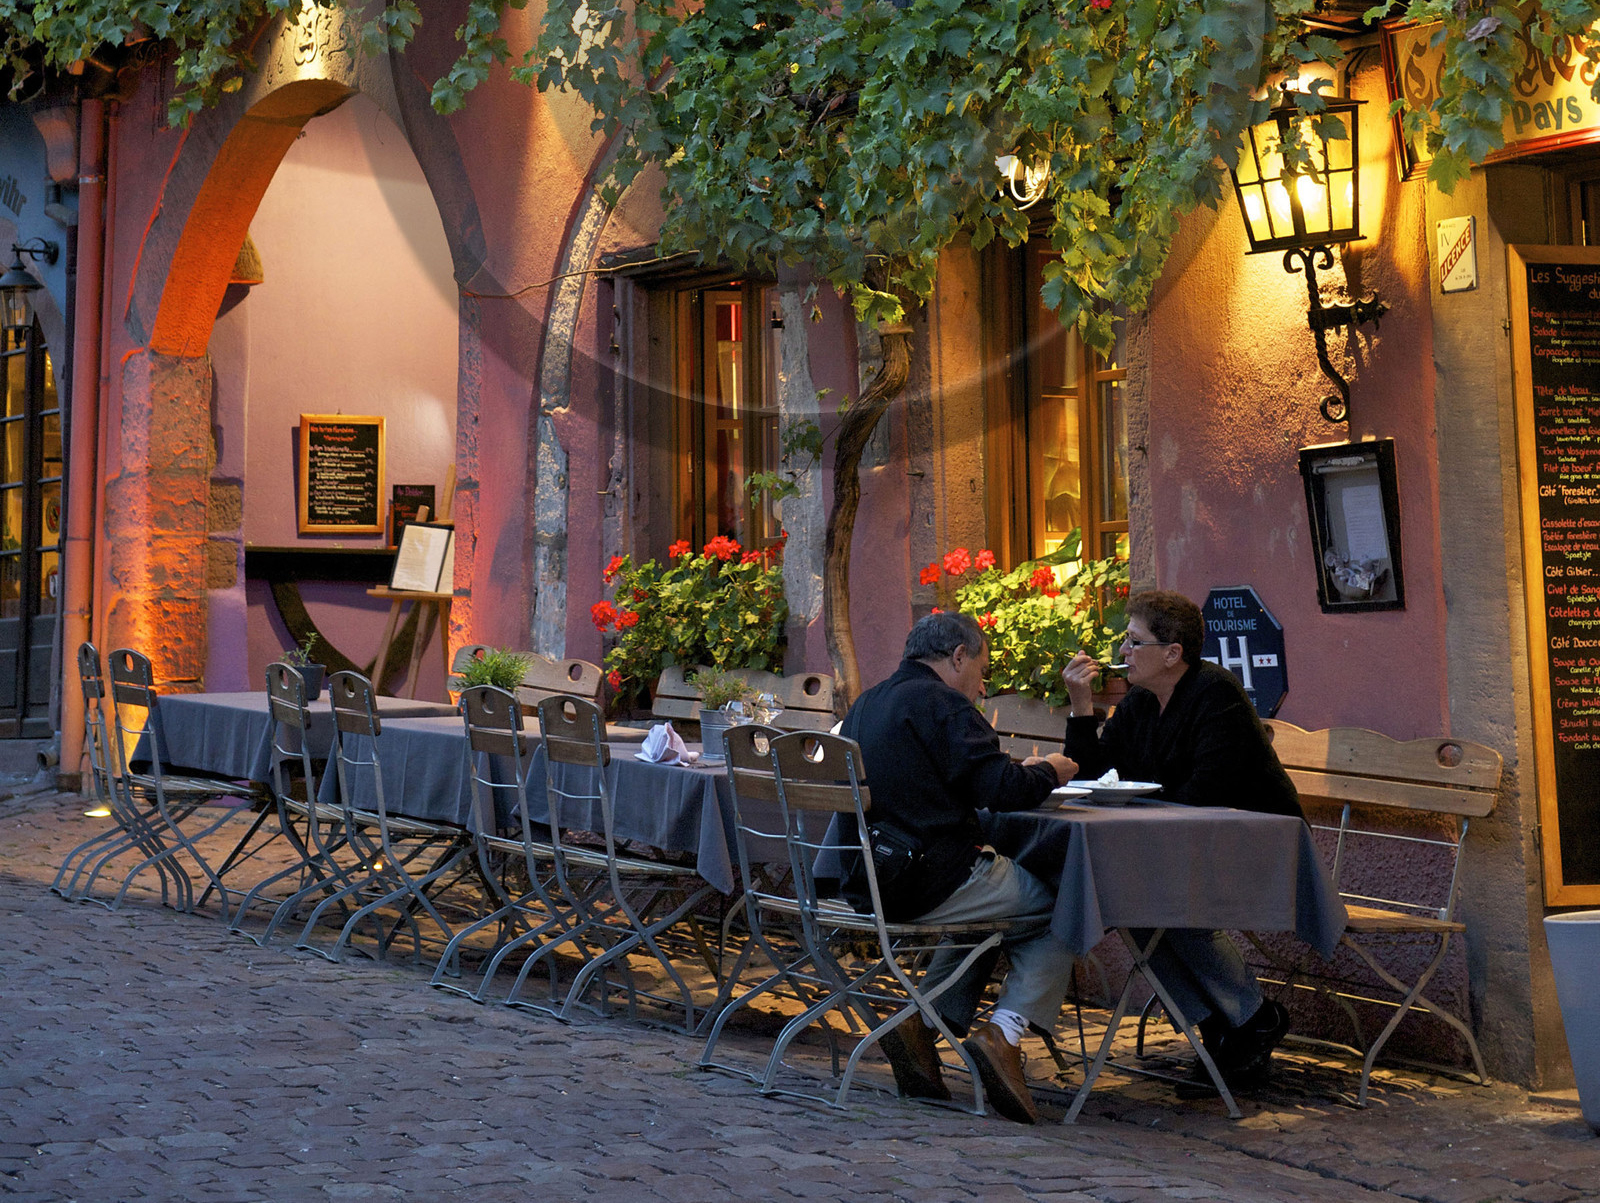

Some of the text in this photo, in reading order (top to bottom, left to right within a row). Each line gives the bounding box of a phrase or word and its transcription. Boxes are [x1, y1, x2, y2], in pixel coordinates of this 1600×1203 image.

[1440, 223, 1471, 283] LICENCE
[1530, 267, 1550, 284] Les
[1533, 325, 1558, 336] Salade
[1534, 344, 1569, 358] Carpaccio
[1571, 349, 1581, 358] de
[1557, 385, 1567, 395] de
[1538, 406, 1561, 416] Jarret
[1539, 425, 1576, 435] Quenelles
[1577, 426, 1587, 435] de
[1539, 445, 1564, 456] Tourte
[1543, 462, 1559, 473] Filet
[1560, 463, 1570, 473] de
[1571, 462, 1594, 473] boeuf
[1539, 484, 1557, 497] Côté
[1541, 518, 1576, 529] Cassolette
[1543, 542, 1572, 554] Escalope
[1572, 542, 1581, 551] de
[1545, 565, 1564, 577] Côté
[1547, 583, 1567, 595] Civet
[1569, 584, 1579, 595] de
[1213, 597, 1247, 609] HOTEL
[1227, 610, 1235, 618] DE
[1549, 606, 1591, 618] Côtelettes
[1207, 619, 1257, 632] TOURISME
[1550, 635, 1570, 649] Côté
[1218, 636, 1255, 691] H
[1553, 657, 1576, 669] Soupe
[1577, 657, 1587, 667] de
[1581, 676, 1592, 685] de
[1559, 718, 1588, 729] Strudel
[1558, 732, 1590, 742] Fondant
